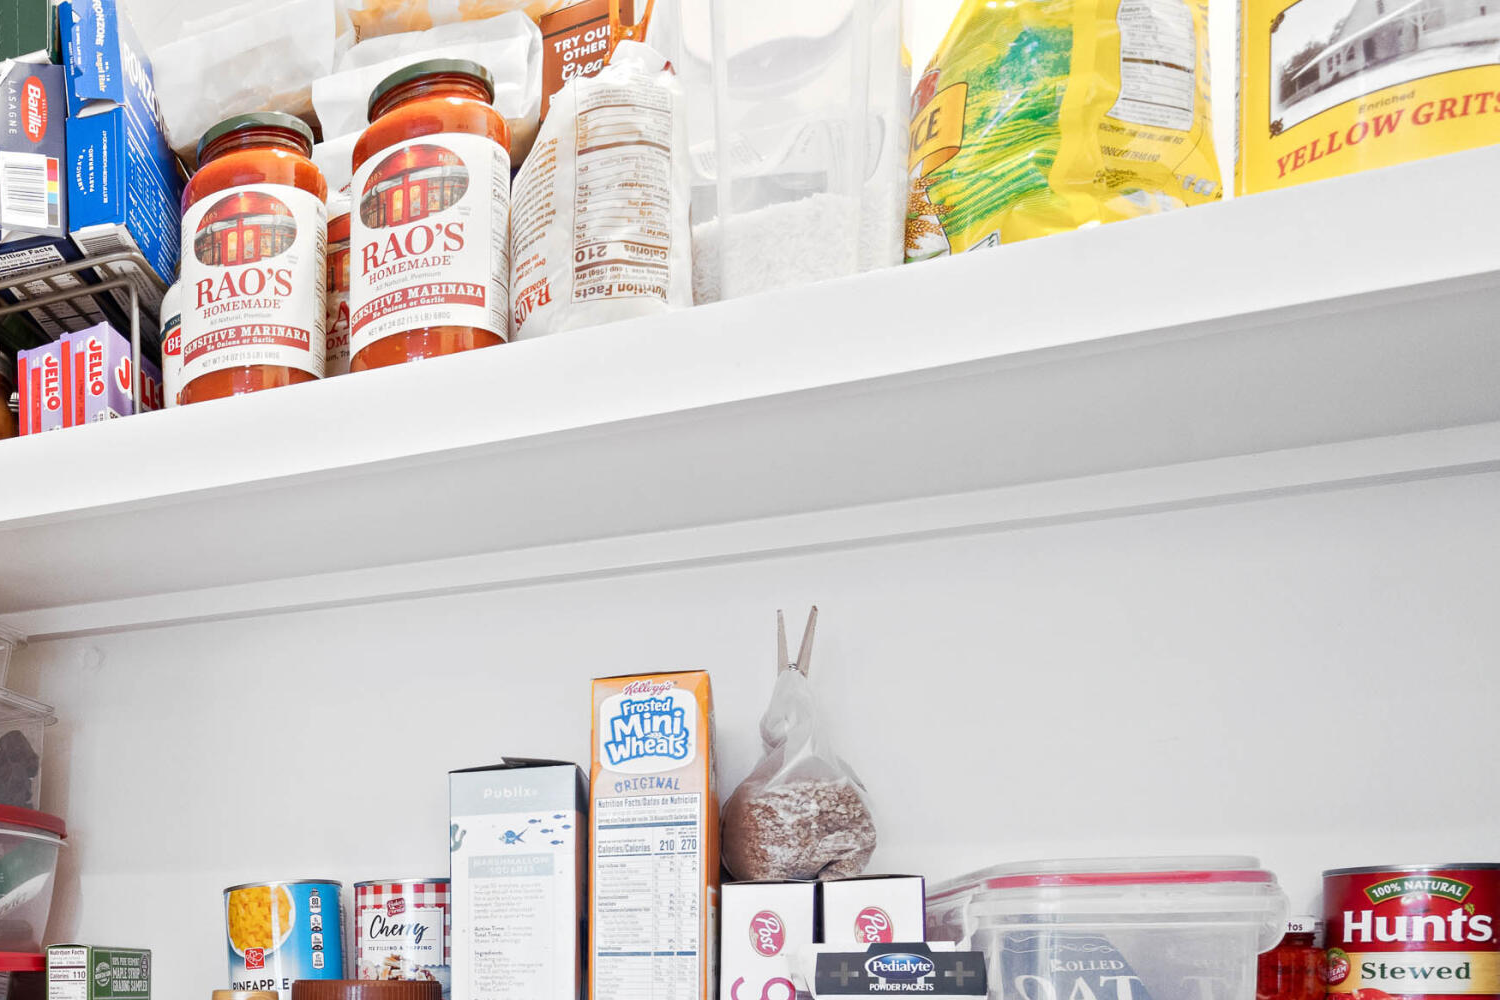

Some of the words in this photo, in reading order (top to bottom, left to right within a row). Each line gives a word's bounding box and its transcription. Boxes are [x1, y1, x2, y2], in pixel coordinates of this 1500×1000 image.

[554, 34, 581, 53] TRY
[563, 39, 607, 62] OTHER
[7, 80, 17, 135] LASAGNE
[27, 83, 42, 138] Barilla
[1359, 90, 1416, 115] Enriched
[1276, 109, 1404, 180] YELLOW
[361, 222, 465, 277] RAO'S
[575, 245, 607, 263] 210
[624, 244, 668, 261] Calories
[368, 255, 451, 286] HOMEMADE
[195, 267, 293, 311] RAO'S
[575, 284, 613, 298] Facts
[617, 283, 668, 300] Nutrition
[203, 298, 282, 319] HOMEMADE
[351, 291, 403, 328] SENSITIVE
[406, 283, 483, 299] MARINARA
[184, 328, 237, 358] SENSITIVE
[240, 325, 309, 343] MARINARA
[624, 680, 672, 696] Kellogg's
[622, 698, 672, 716] Frosted
[613, 711, 683, 742] Mini
[607, 734, 687, 764] Wheats
[484, 785, 533, 799] Publix
[615, 776, 681, 793] ORIGINAL
[660, 839, 675, 850] 210
[681, 839, 697, 850] 270
[1371, 883, 1401, 898] 100%
[1403, 880, 1464, 897] NATURAL
[370, 914, 429, 945] Cherry
[754, 916, 779, 953] Post
[867, 912, 887, 943] Pos
[112, 967, 128, 979] MAPLE
[872, 960, 932, 974] Pedialyte
[1050, 958, 1125, 972] ROLLED
[1361, 962, 1472, 980] Stewed
[73, 971, 86, 979] 110
[902, 983, 934, 991] PACKETS
